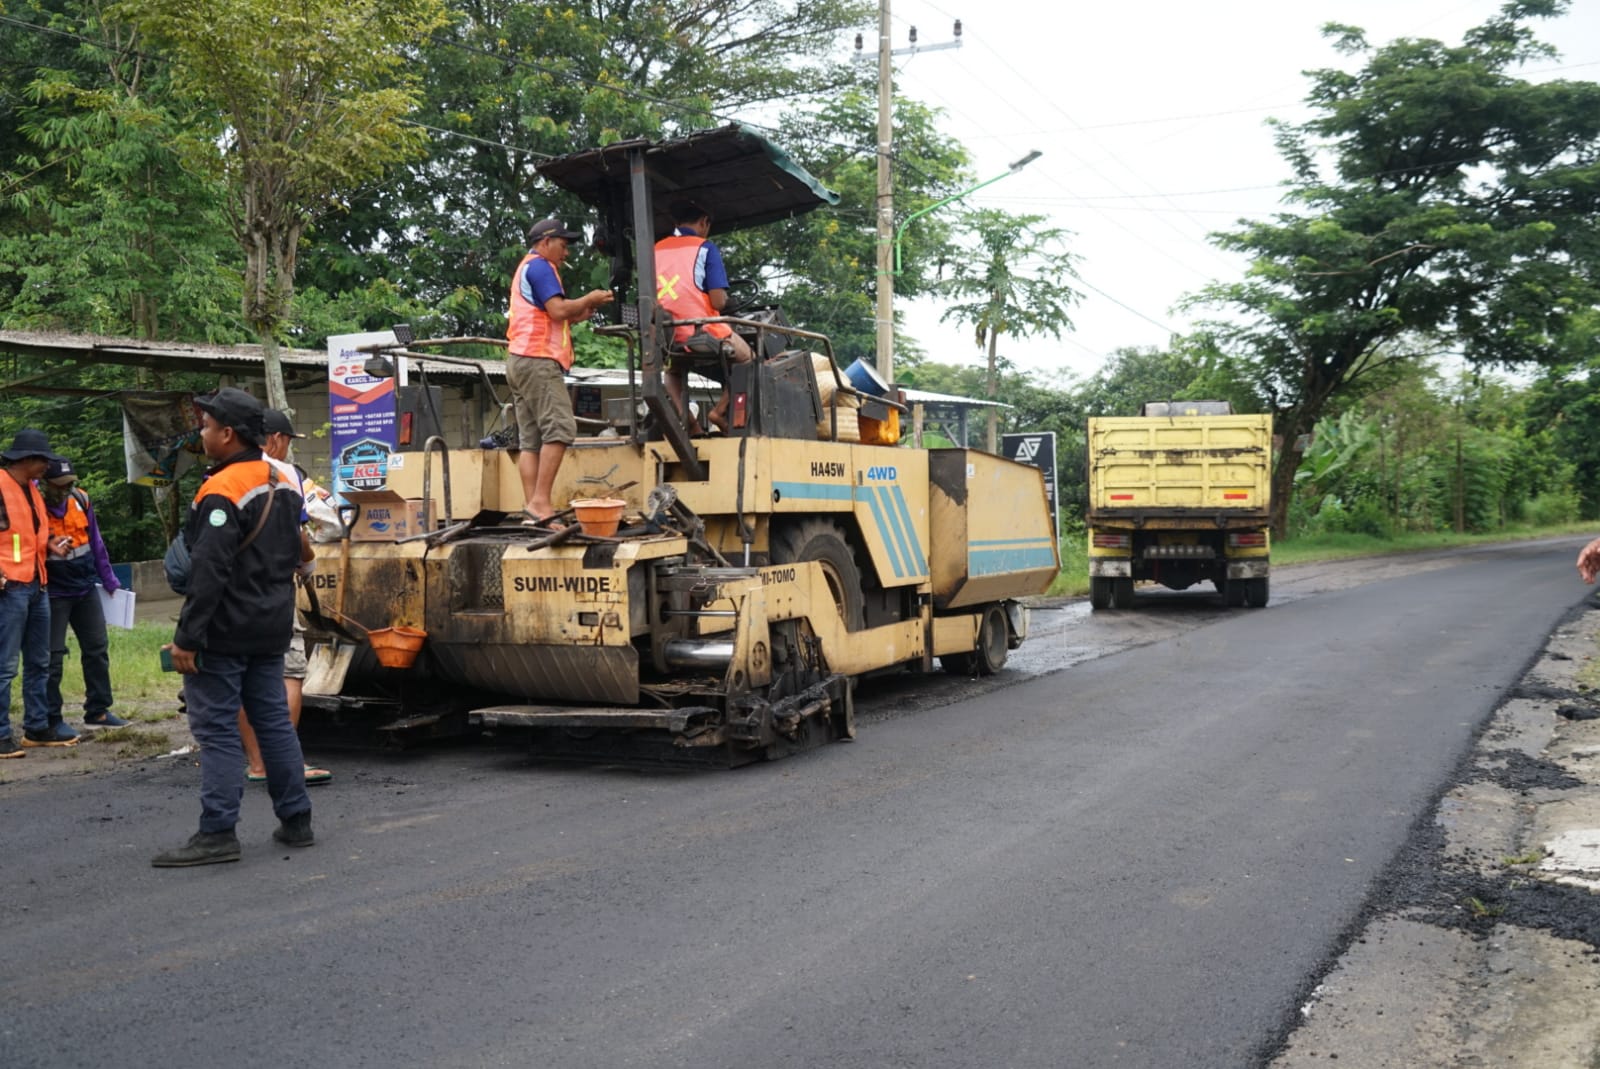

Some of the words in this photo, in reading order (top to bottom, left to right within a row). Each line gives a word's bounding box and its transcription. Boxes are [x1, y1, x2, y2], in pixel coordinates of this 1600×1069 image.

[353, 463, 382, 478] KCL
[811, 461, 845, 477] HA45W
[867, 466, 897, 481] 4WD
[367, 508, 391, 521] AQUA
[513, 576, 610, 593] SUMI-WIDE
